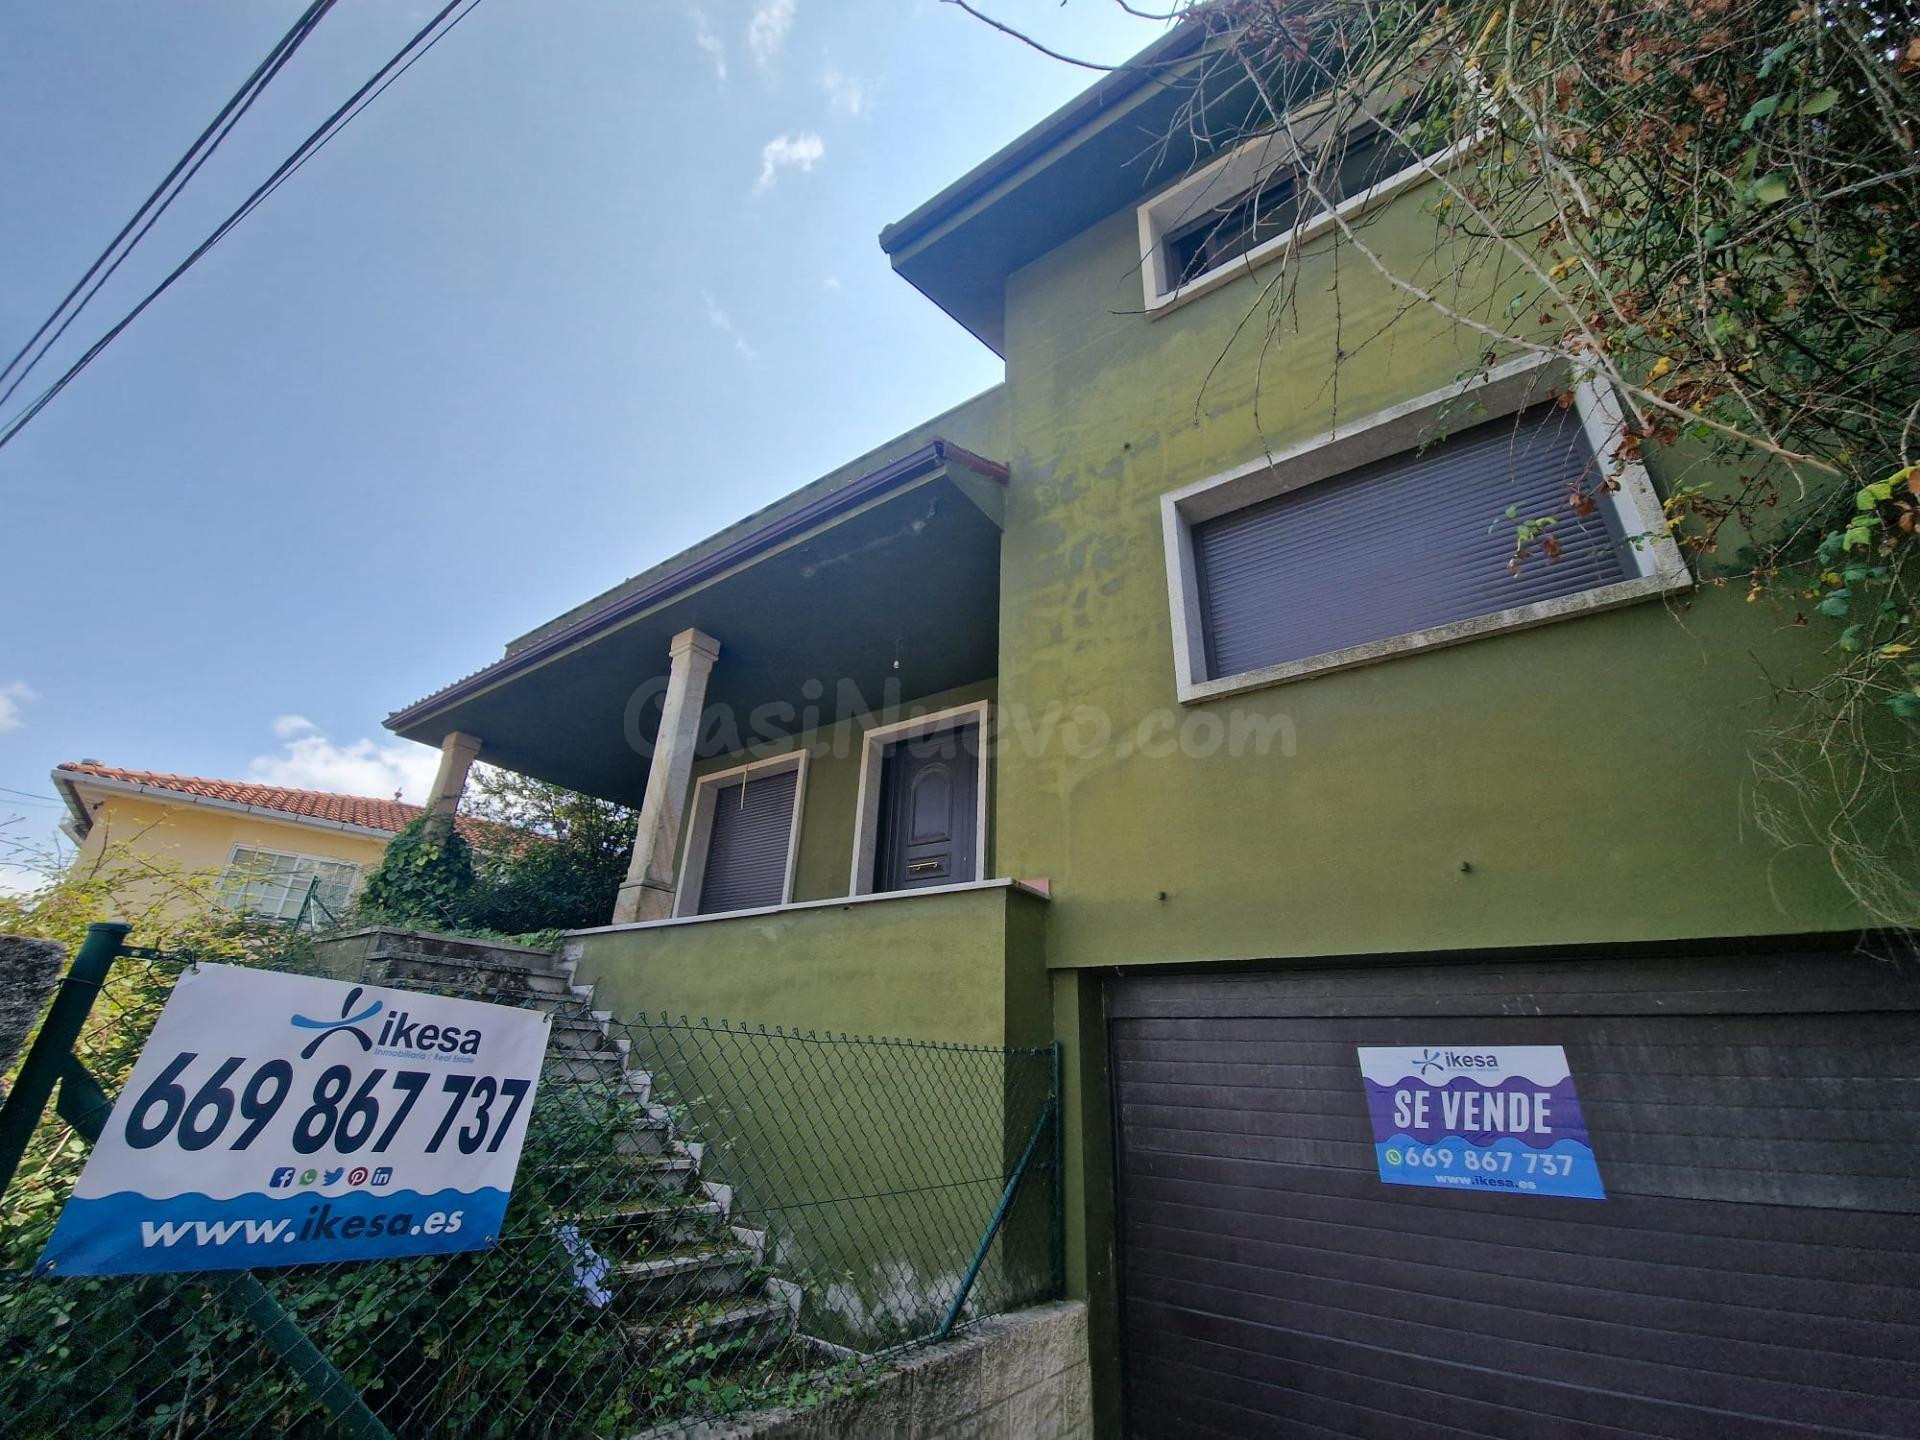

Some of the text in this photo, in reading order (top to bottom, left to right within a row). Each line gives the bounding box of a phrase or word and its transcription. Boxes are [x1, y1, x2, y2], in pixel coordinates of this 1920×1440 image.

[378, 1010, 482, 1055] ikesa
[1445, 1051, 1499, 1068] ikesa
[125, 1052, 532, 1154] 669 867 737
[1394, 1089, 1553, 1134] SE VENDE
[1405, 1147, 1574, 1177] 669 867 737
[1434, 1173, 1537, 1190] www.ikesa.es
[141, 1203, 465, 1248] www.ikesa.es
